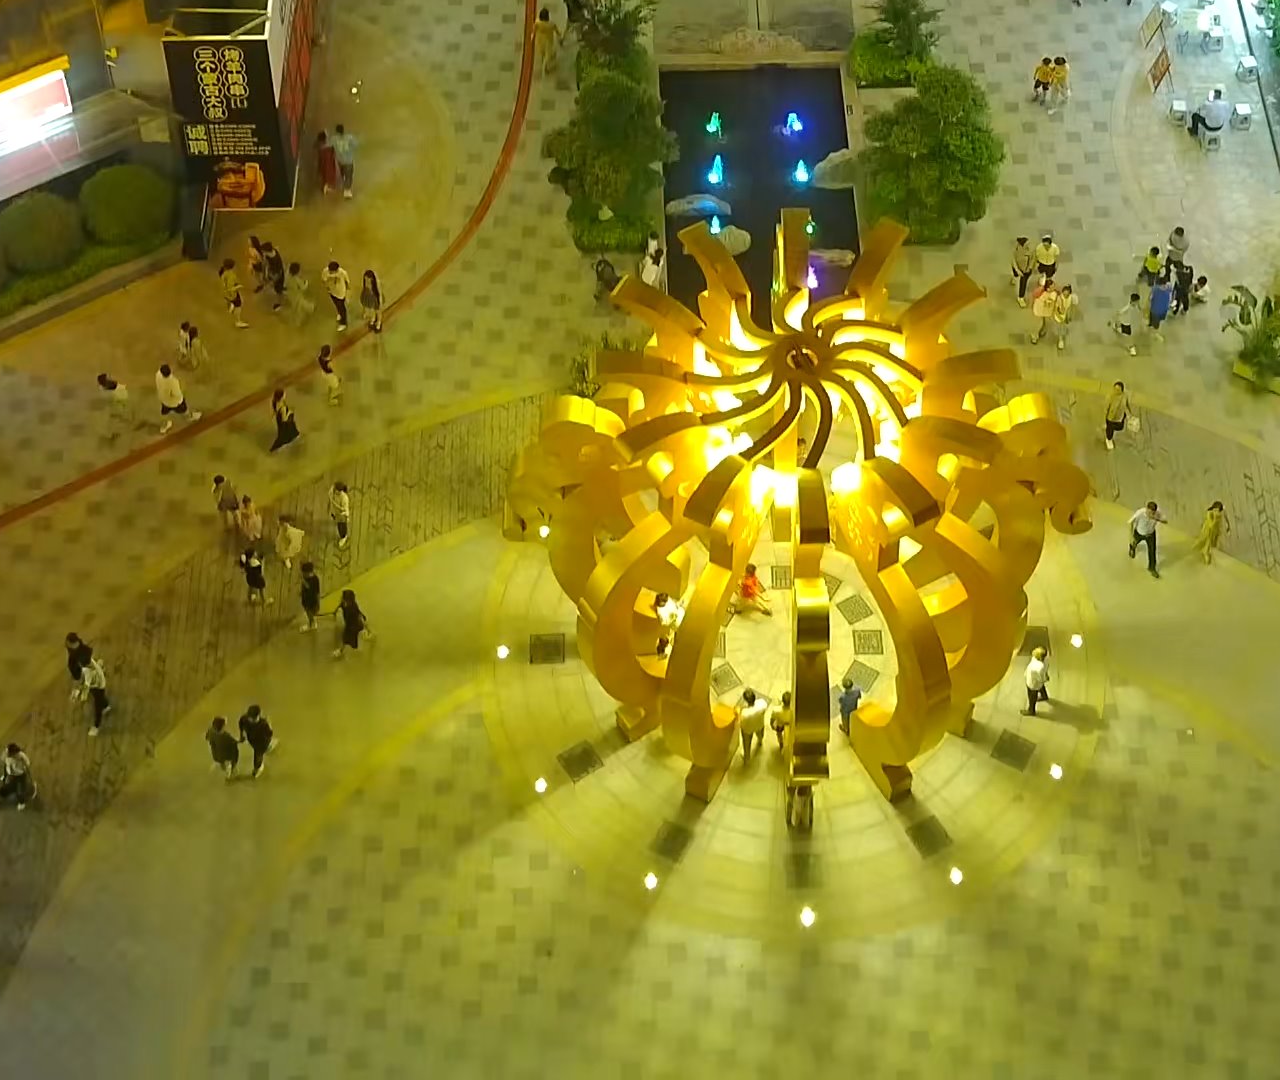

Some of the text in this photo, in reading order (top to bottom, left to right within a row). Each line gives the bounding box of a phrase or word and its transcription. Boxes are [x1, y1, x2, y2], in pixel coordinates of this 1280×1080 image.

[196, 47, 225, 120] 三个蒙古大叔
